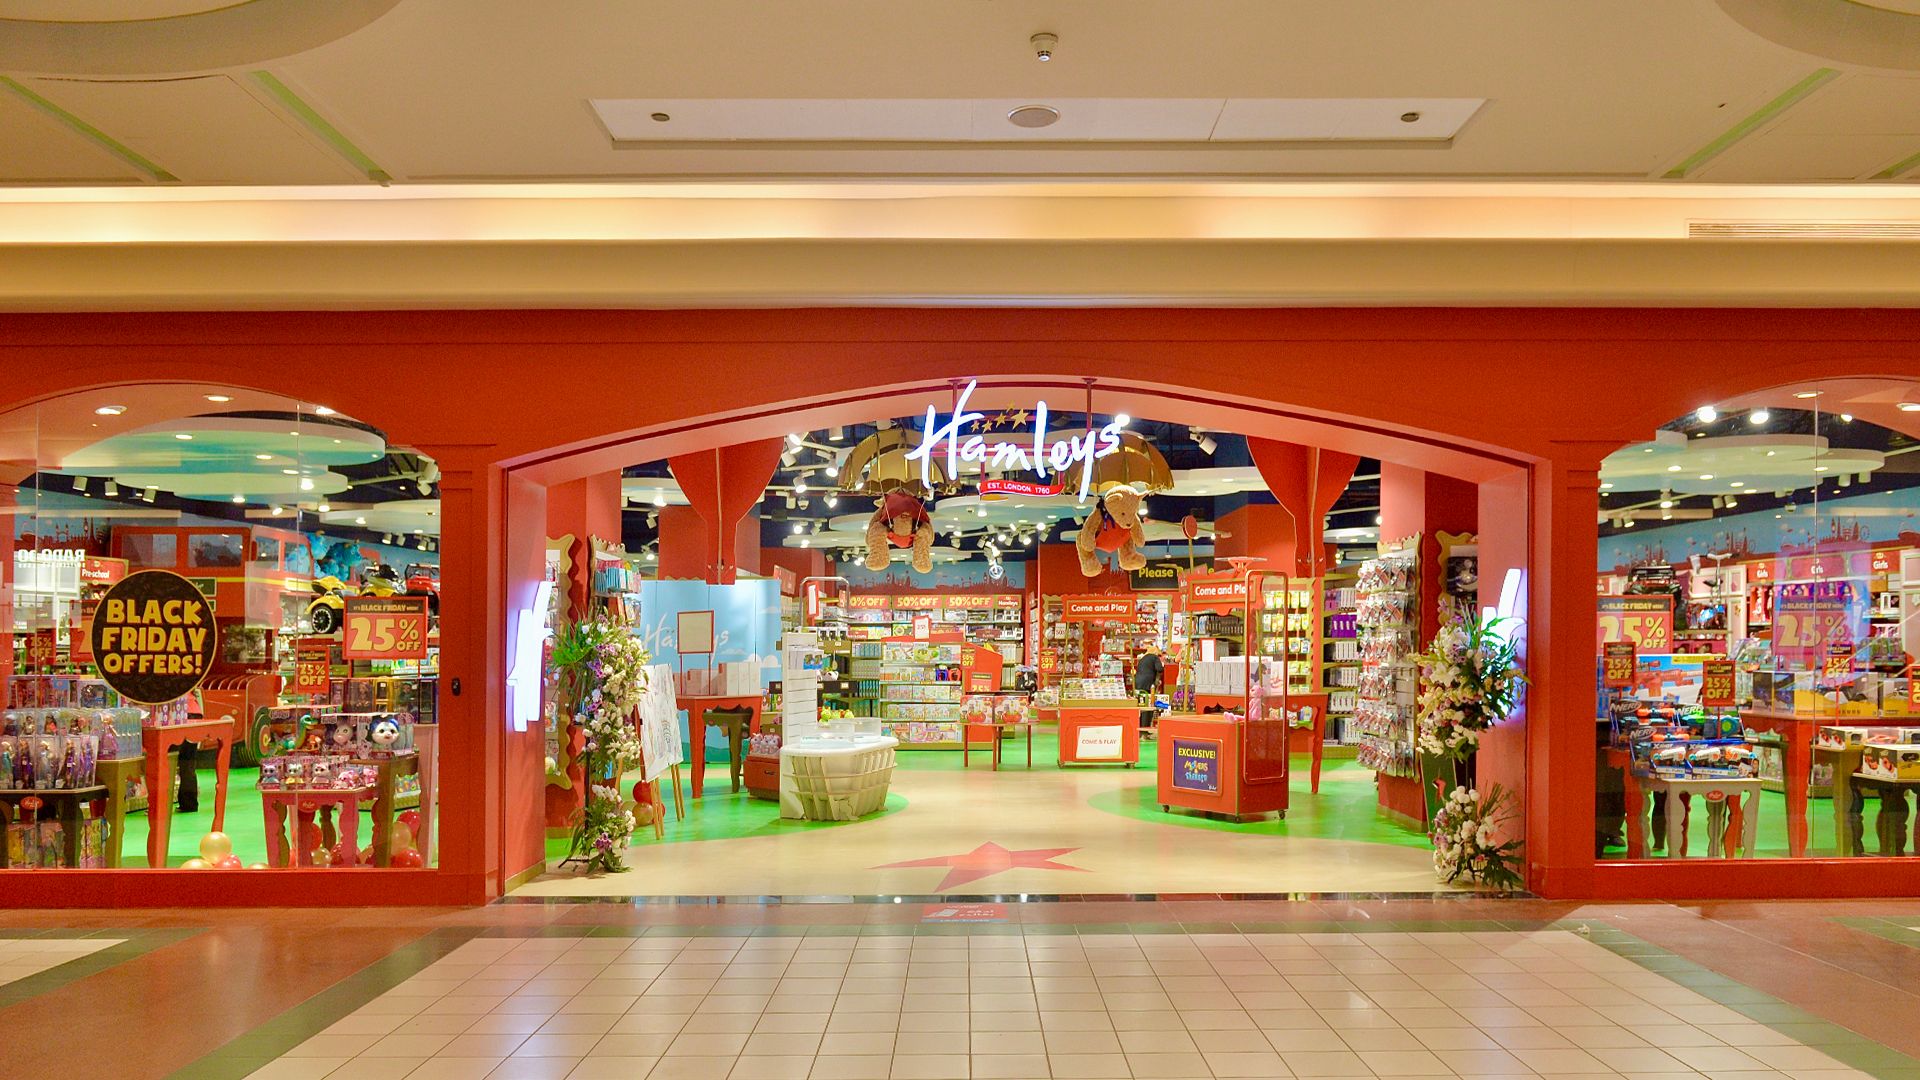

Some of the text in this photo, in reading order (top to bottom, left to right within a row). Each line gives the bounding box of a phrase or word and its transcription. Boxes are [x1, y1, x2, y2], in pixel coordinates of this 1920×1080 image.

[904, 379, 1130, 504] Hamleys
[987, 482, 1002, 490] EST.
[1003, 483, 1031, 492] LONDON
[82, 569, 110, 579] Pre-school
[1138, 568, 1174, 578] Please
[1195, 584, 1250, 596] Come and Pla
[848, 597, 886, 607] 0% OFF
[897, 597, 938, 607] 50% OFF
[949, 597, 991, 607] 50% OFF
[106, 599, 202, 626] BLACK
[1094, 604, 1109, 612] and
[1110, 604, 1128, 613] Play
[351, 617, 419, 651] 25%
[1599, 615, 1665, 649] 25%
[1778, 614, 1846, 648] 25%
[101, 627, 207, 652] FRIDAY
[1643, 639, 1667, 649] OFF
[397, 642, 421, 651] OFF
[103, 653, 203, 675] OFFERS!
[1607, 658, 1632, 669] 25%
[299, 664, 325, 675] 25%
[1607, 669, 1632, 680] OFF
[1825, 668, 1850, 677] OFF
[299, 675, 326, 686] OFF
[1706, 677, 1731, 689] 25%
[1706, 688, 1731, 699] OFF
[1178, 747, 1216, 760] EXCLUSIVE!
